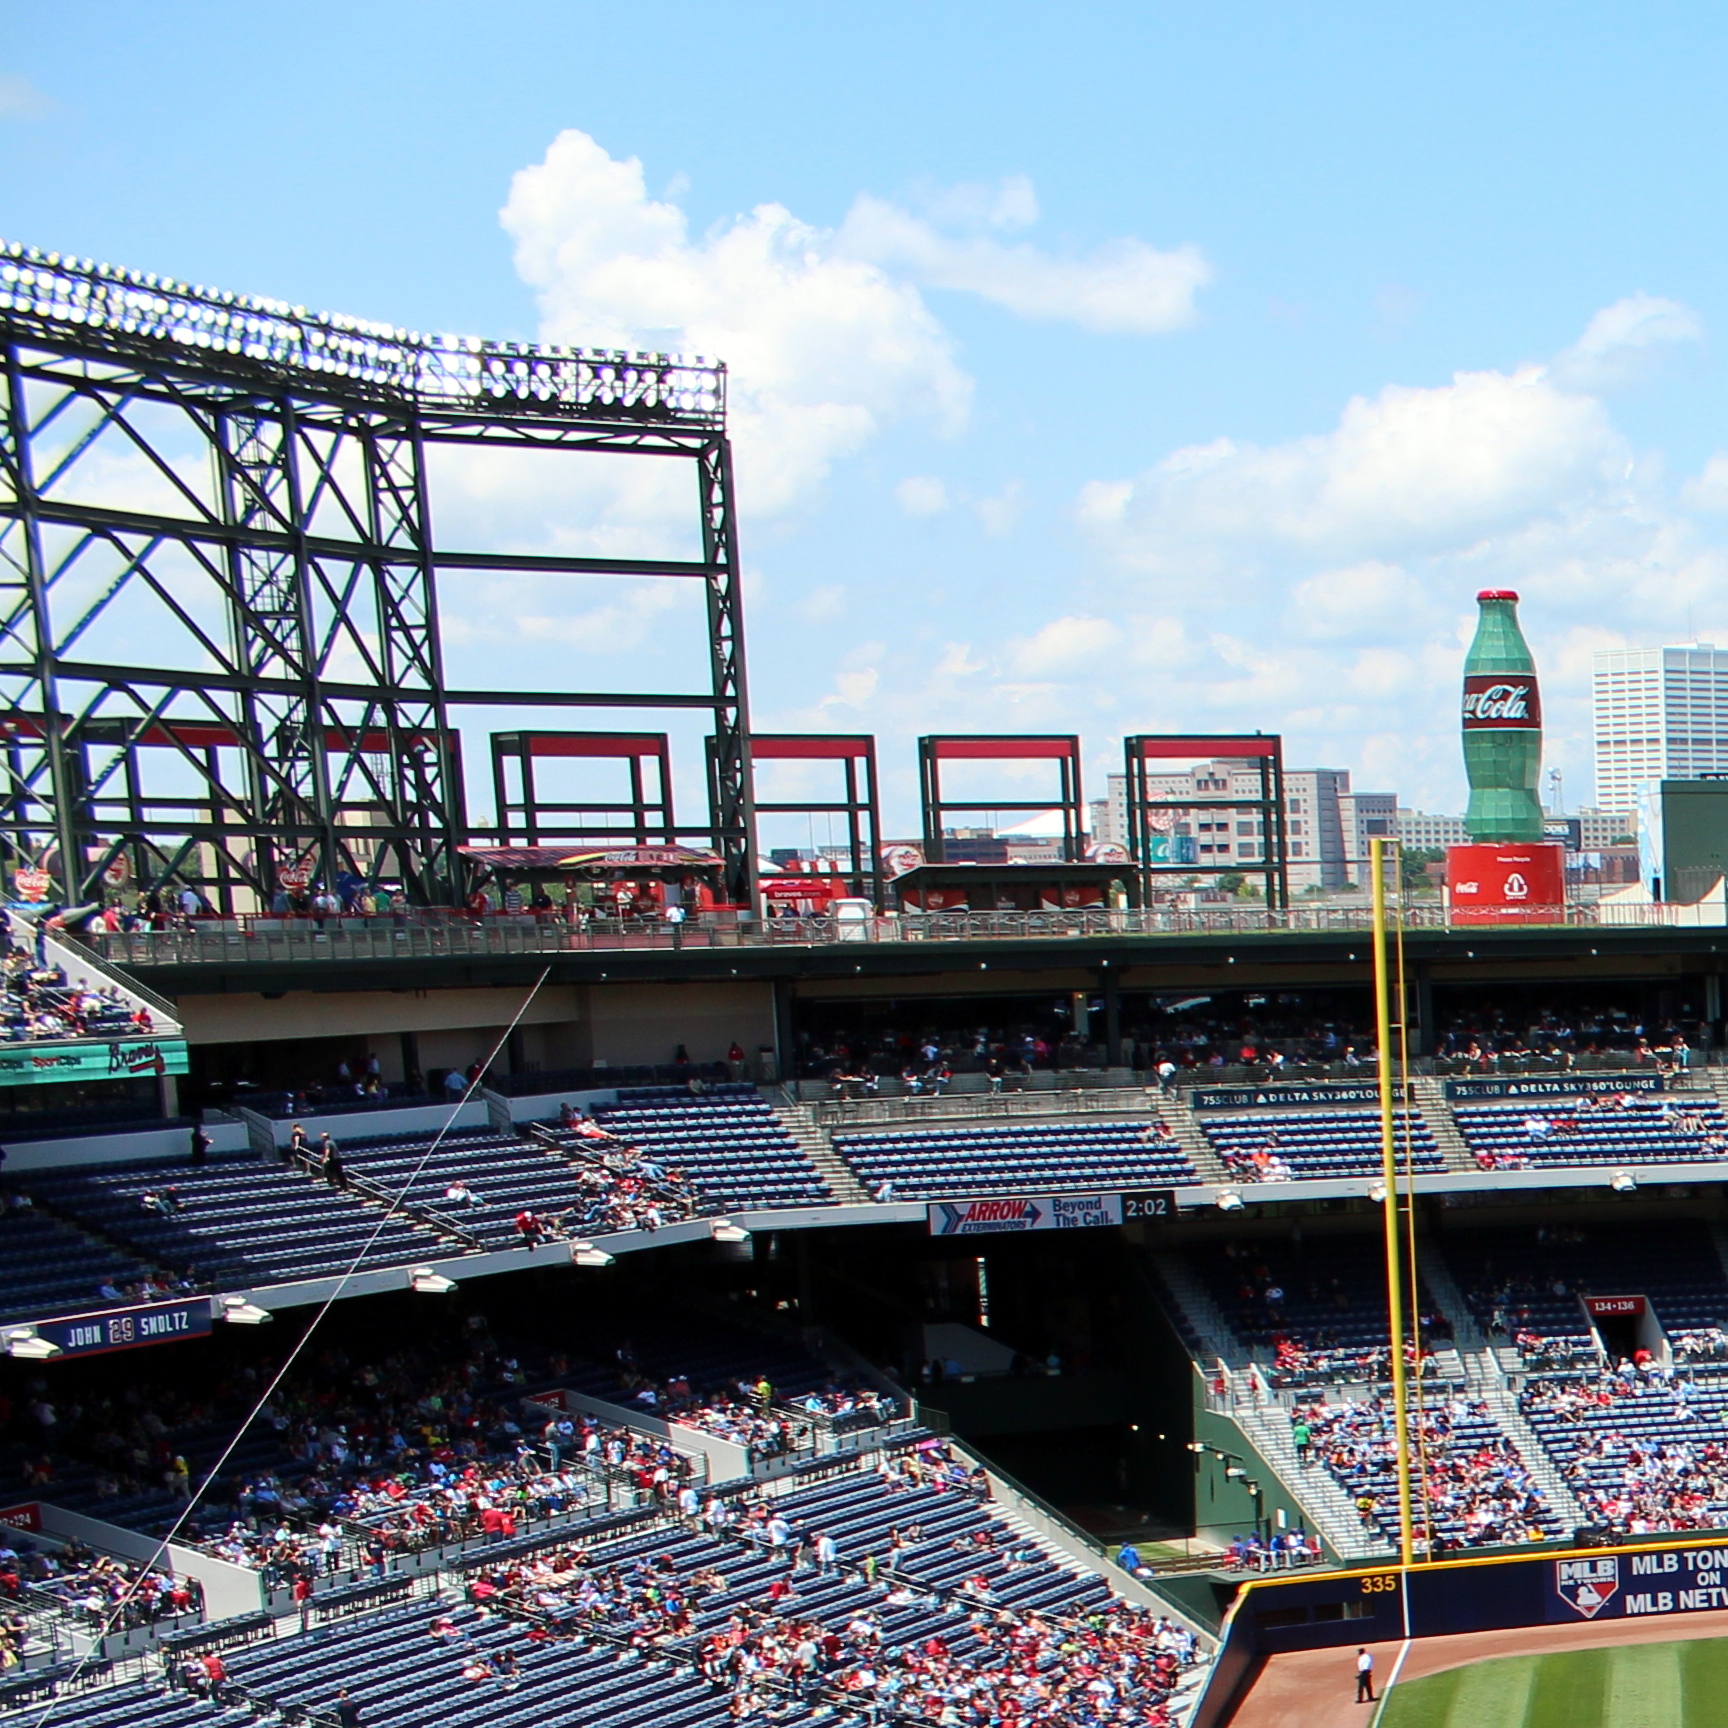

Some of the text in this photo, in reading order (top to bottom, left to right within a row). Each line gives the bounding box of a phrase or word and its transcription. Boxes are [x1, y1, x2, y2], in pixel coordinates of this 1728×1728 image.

[1520, 1081, 1560, 1094] DELTA
[964, 1200, 1028, 1222] ARROW
[1053, 1197, 1101, 1213] Beyond
[1126, 1199, 1167, 1216] 2:02
[961, 1220, 1027, 1233] EXTERMINATORS
[1054, 1213, 1081, 1227] The
[68, 1311, 189, 1348] JOHN 29 SMOLTZ
[1560, 1560, 1615, 1580] MLB
[1631, 1554, 1679, 1576] MLB
[1361, 1574, 1396, 1594] 335
[1560, 1577, 1615, 1586] NETWORK
[1696, 1570, 1721, 1586] ON
[1625, 1593, 1674, 1615] MLB
